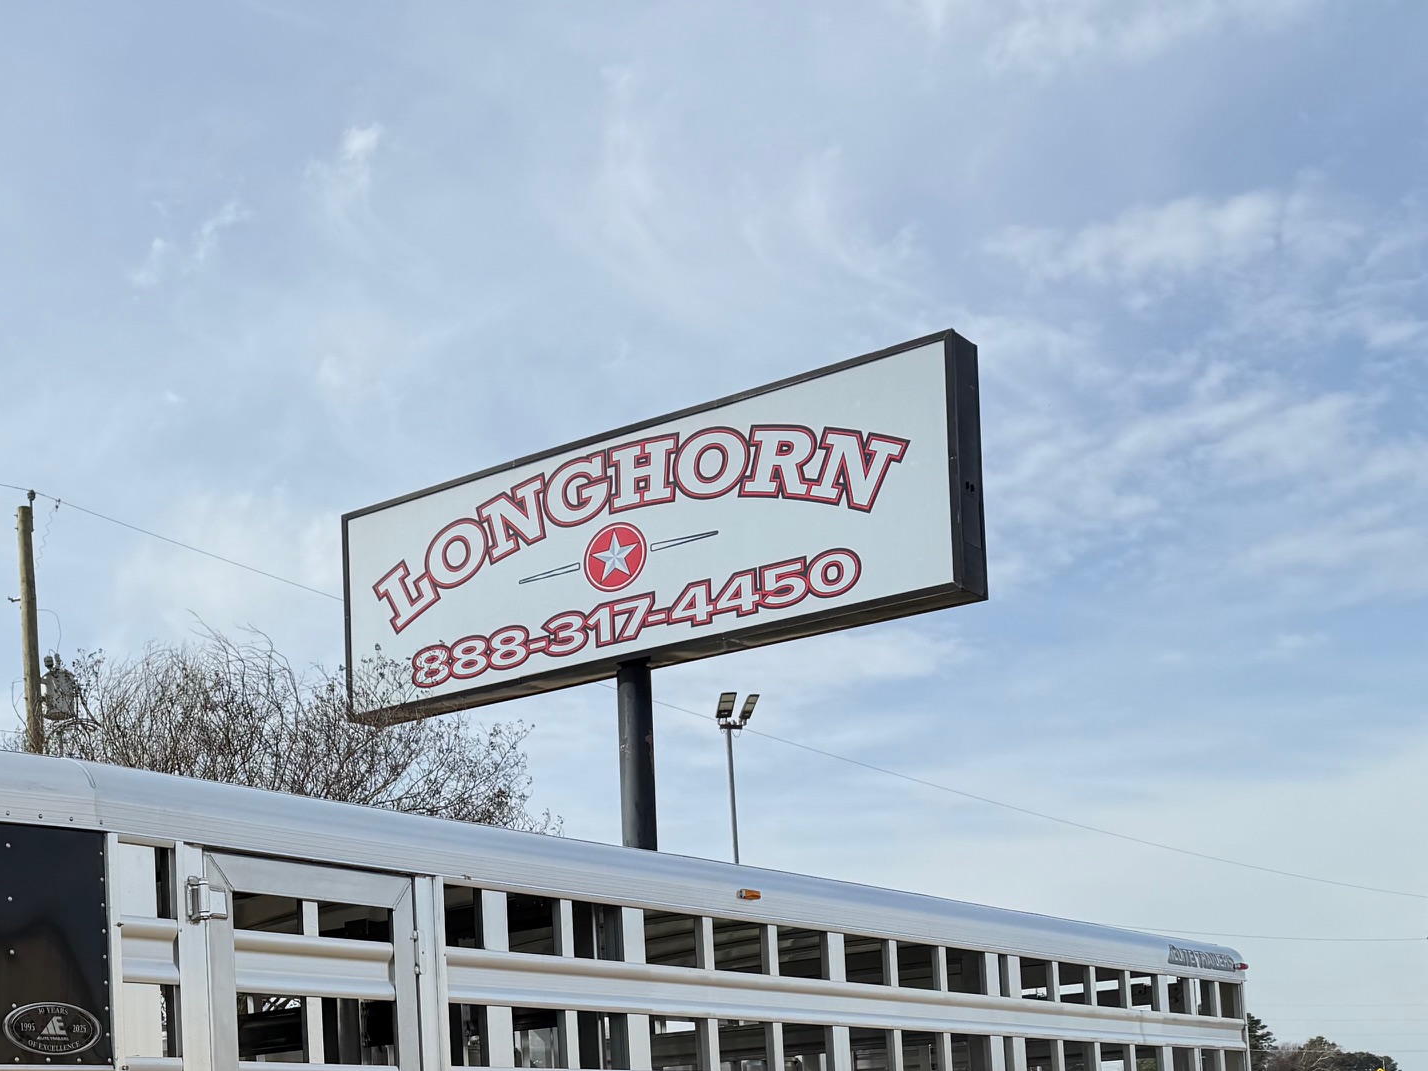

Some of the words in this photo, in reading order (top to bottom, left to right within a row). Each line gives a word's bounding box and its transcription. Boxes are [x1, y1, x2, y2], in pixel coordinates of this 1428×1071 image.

[373, 424, 910, 634] LONGHORN
[412, 547, 862, 689] 888-317-4450
[46, 1007, 69, 1015] YEARS
[20, 1022, 36, 1032] 1995
[72, 1024, 87, 1033] 2025
[28, 1039, 38, 1048] OF
[38, 1040, 81, 1052] EXCELLENCE
